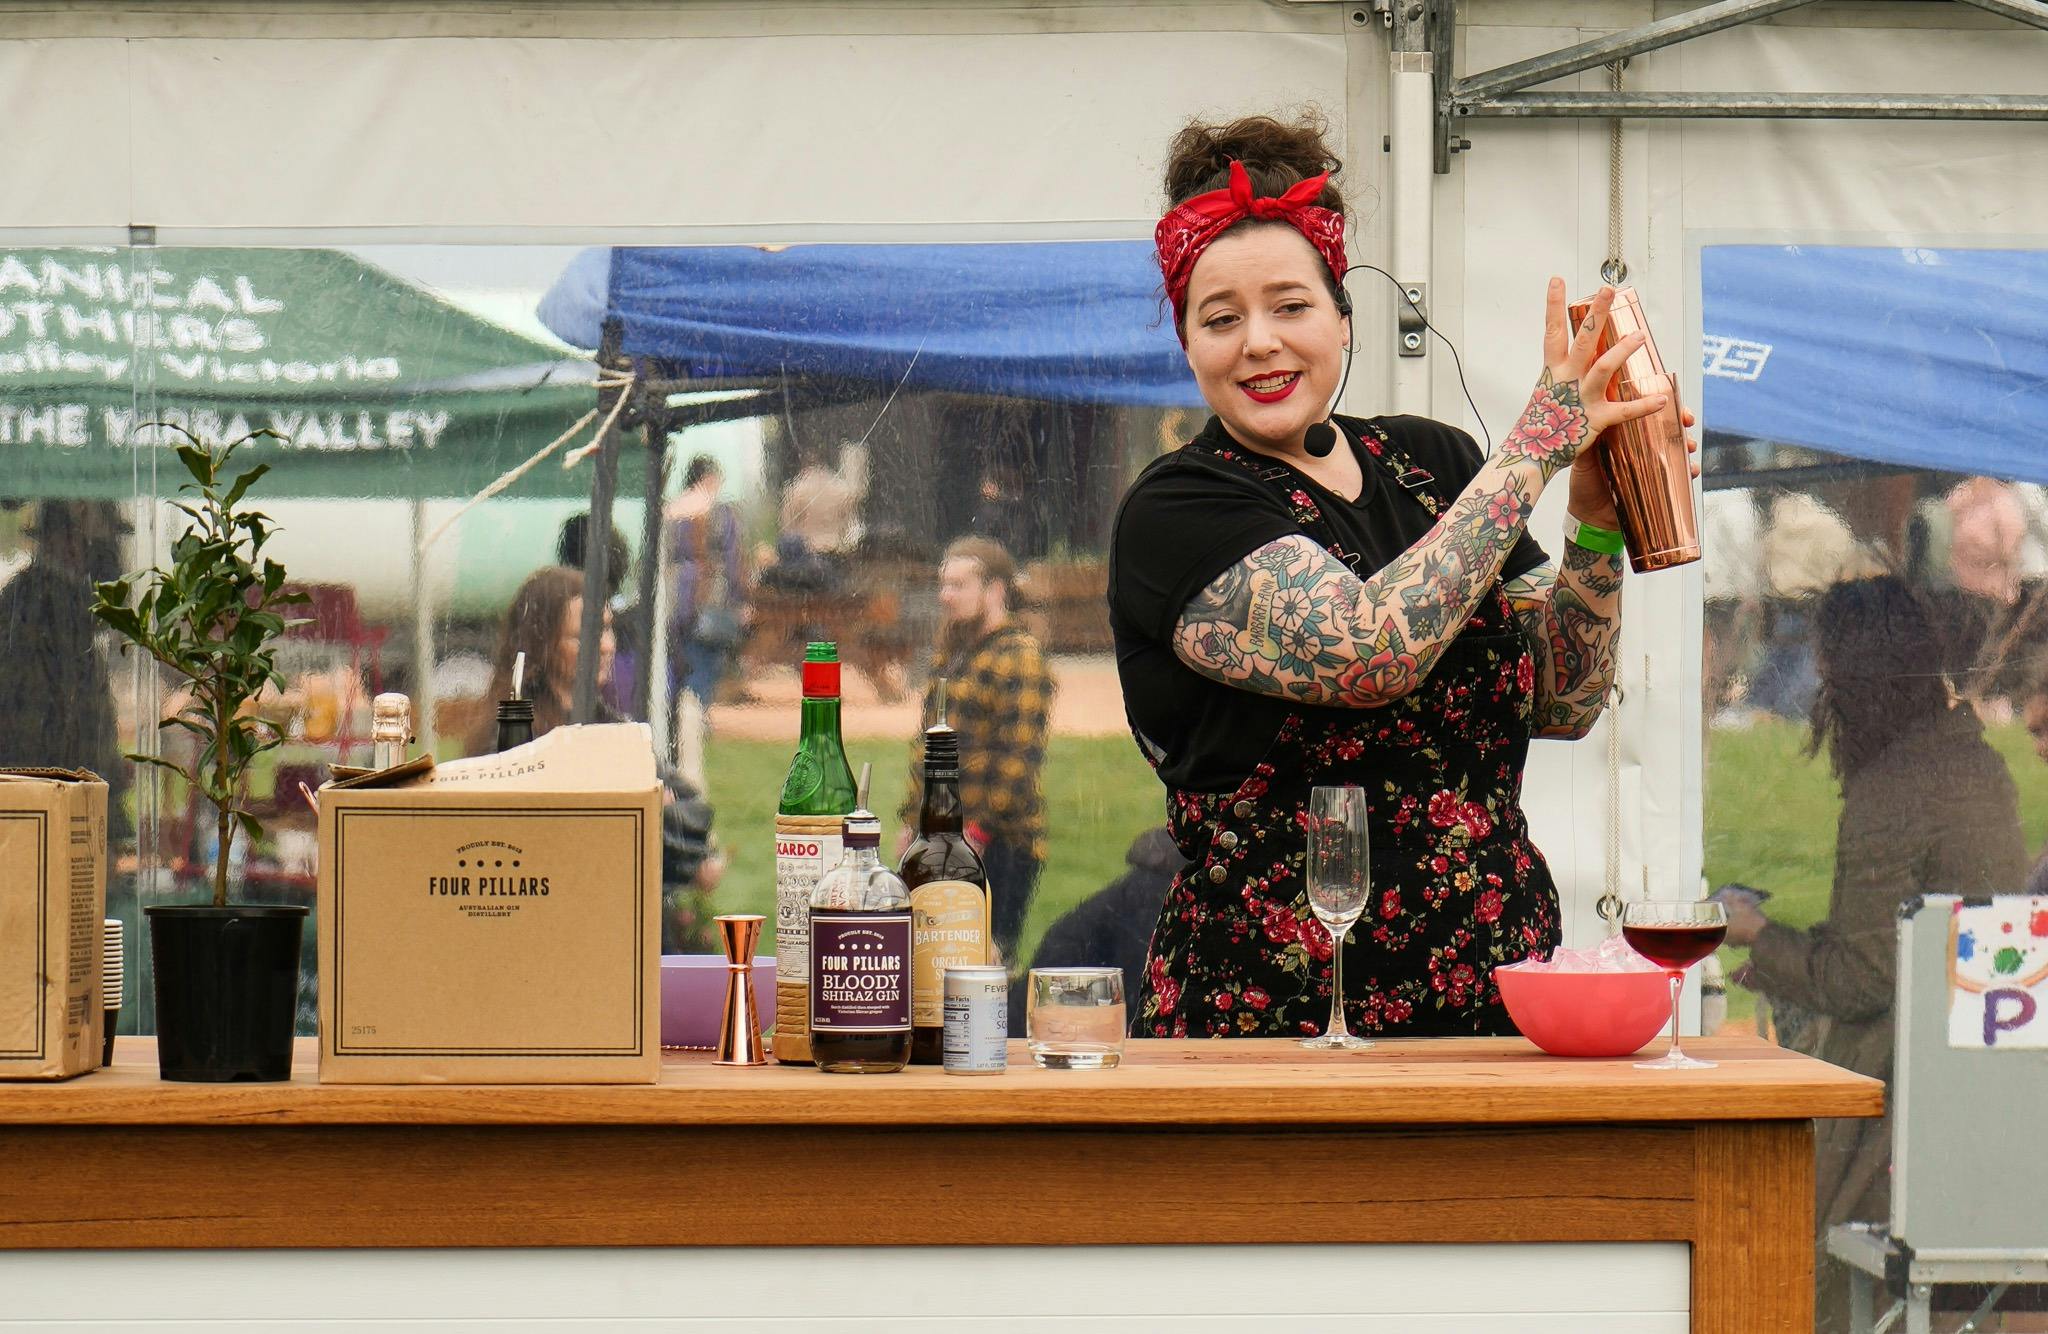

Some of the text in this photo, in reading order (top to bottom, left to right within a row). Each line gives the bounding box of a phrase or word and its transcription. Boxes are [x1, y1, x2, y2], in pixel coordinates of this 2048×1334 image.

[268, 407, 452, 451] VALLEY
[430, 760, 546, 783] OUR PILLARS
[456, 840, 490, 854] PROUDLY
[429, 876, 550, 896] FOUR PILLARS
[915, 929, 981, 945] BARTENDER
[822, 955, 848, 970] FOUR
[853, 955, 900, 970] PILLARS
[931, 956, 969, 969] ORGEAT
[822, 974, 900, 990] BLOODY
[822, 990, 900, 1001] SHIRAZ GIN
[1983, 988, 2037, 1046] P
